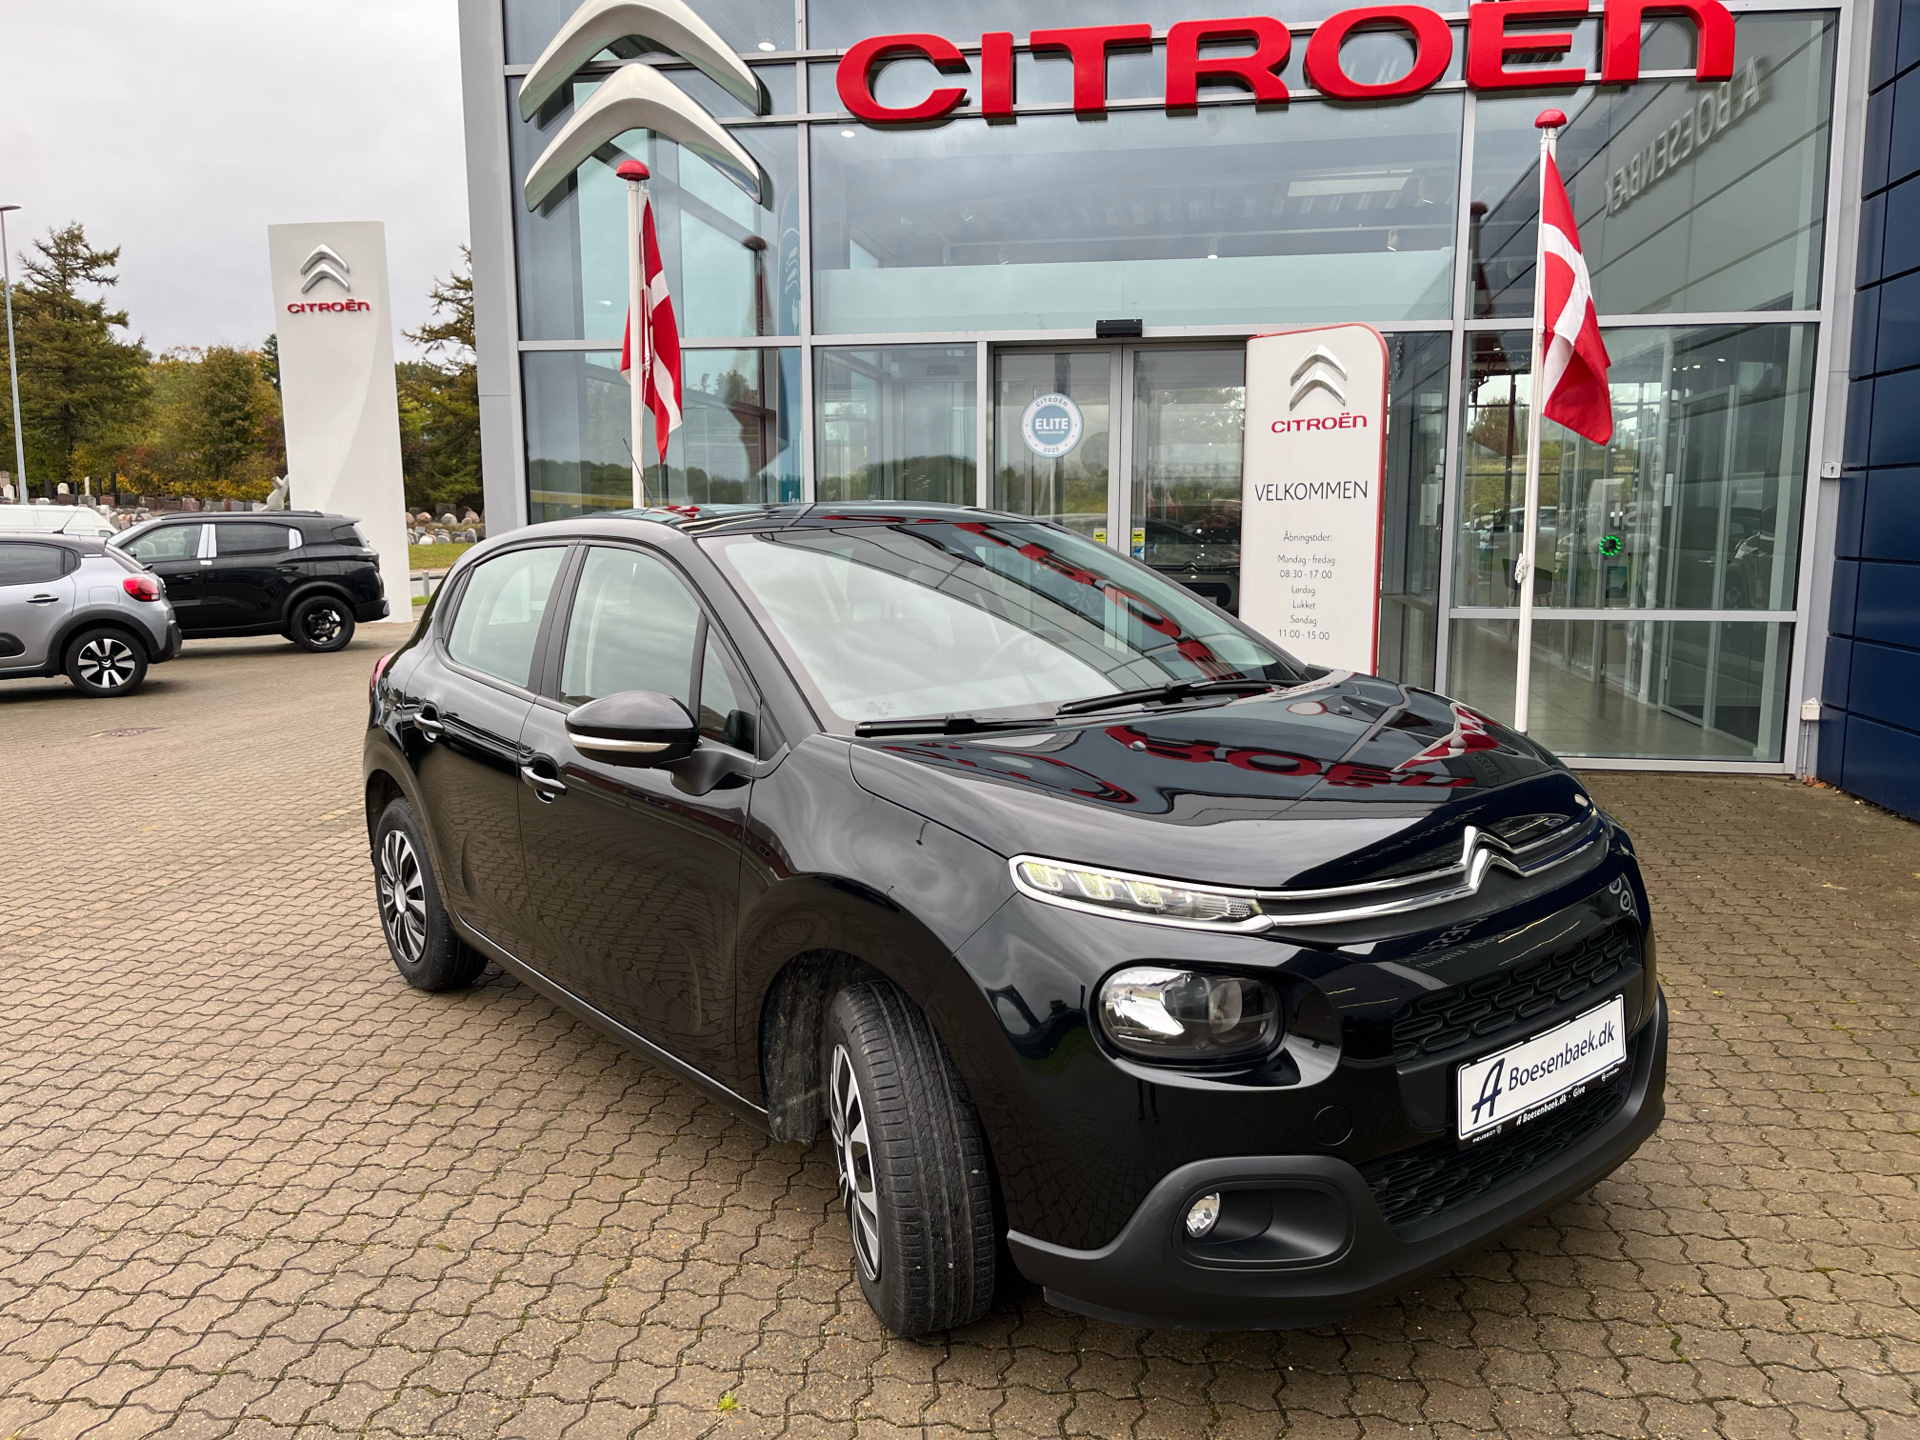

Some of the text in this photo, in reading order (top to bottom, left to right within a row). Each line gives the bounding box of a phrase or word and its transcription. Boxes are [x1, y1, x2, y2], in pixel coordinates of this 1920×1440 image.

[286, 298, 370, 314] CITROËN
[1035, 417, 1069, 430] ELITE
[1270, 412, 1368, 433] CITROËN
[1254, 480, 1368, 501] VELKOMMEN
[1283, 530, 1333, 545] Åbningstider:
[1277, 554, 1307, 567] Mandag
[1312, 554, 1336, 567] fredag
[1279, 569, 1303, 579] 08:30
[1309, 569, 1333, 579] 17:00
[1291, 585, 1316, 597] Lørdag
[1292, 600, 1316, 609] Lukket
[1290, 614, 1317, 628] Søndag
[1278, 629, 1301, 639] 11:00
[1307, 630, 1330, 641] 15:00
[1508, 1020, 1615, 1092] Boesenbaek.dk
